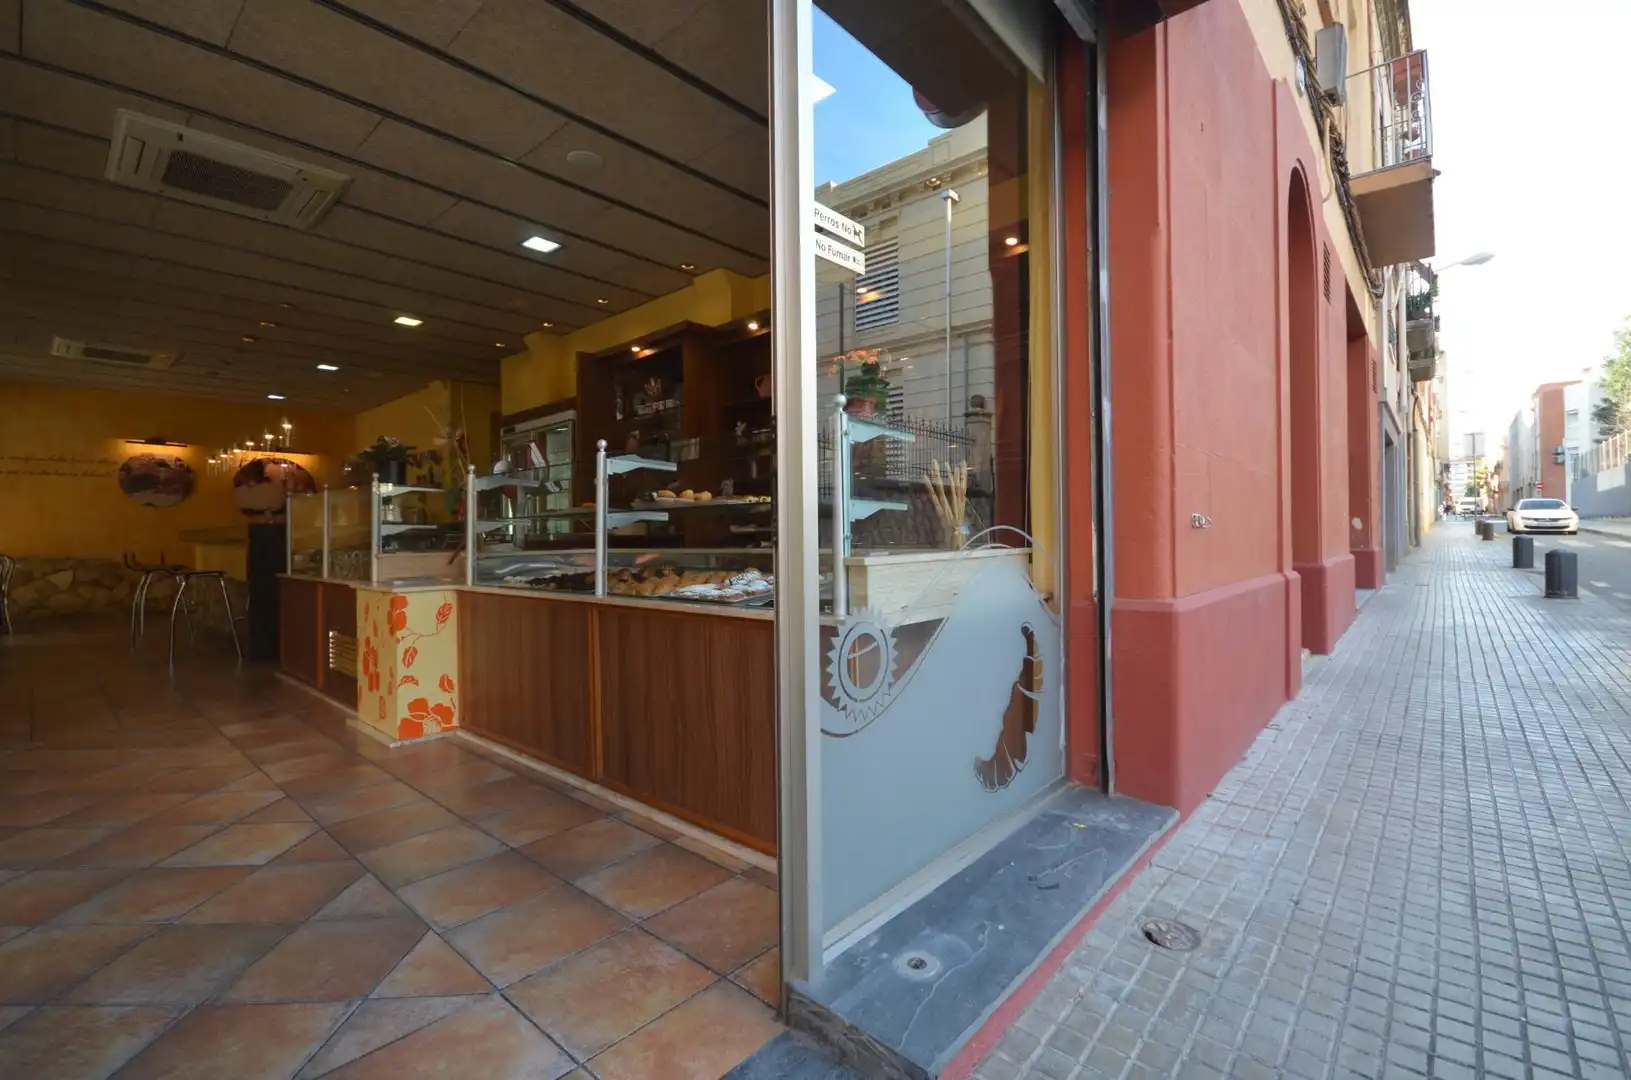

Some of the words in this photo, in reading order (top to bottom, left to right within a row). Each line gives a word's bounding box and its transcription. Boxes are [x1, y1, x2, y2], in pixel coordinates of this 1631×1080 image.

[814, 208, 840, 229] Perros
[841, 222, 852, 234] No
[815, 238, 826, 251] No
[827, 244, 851, 263] Fumar
